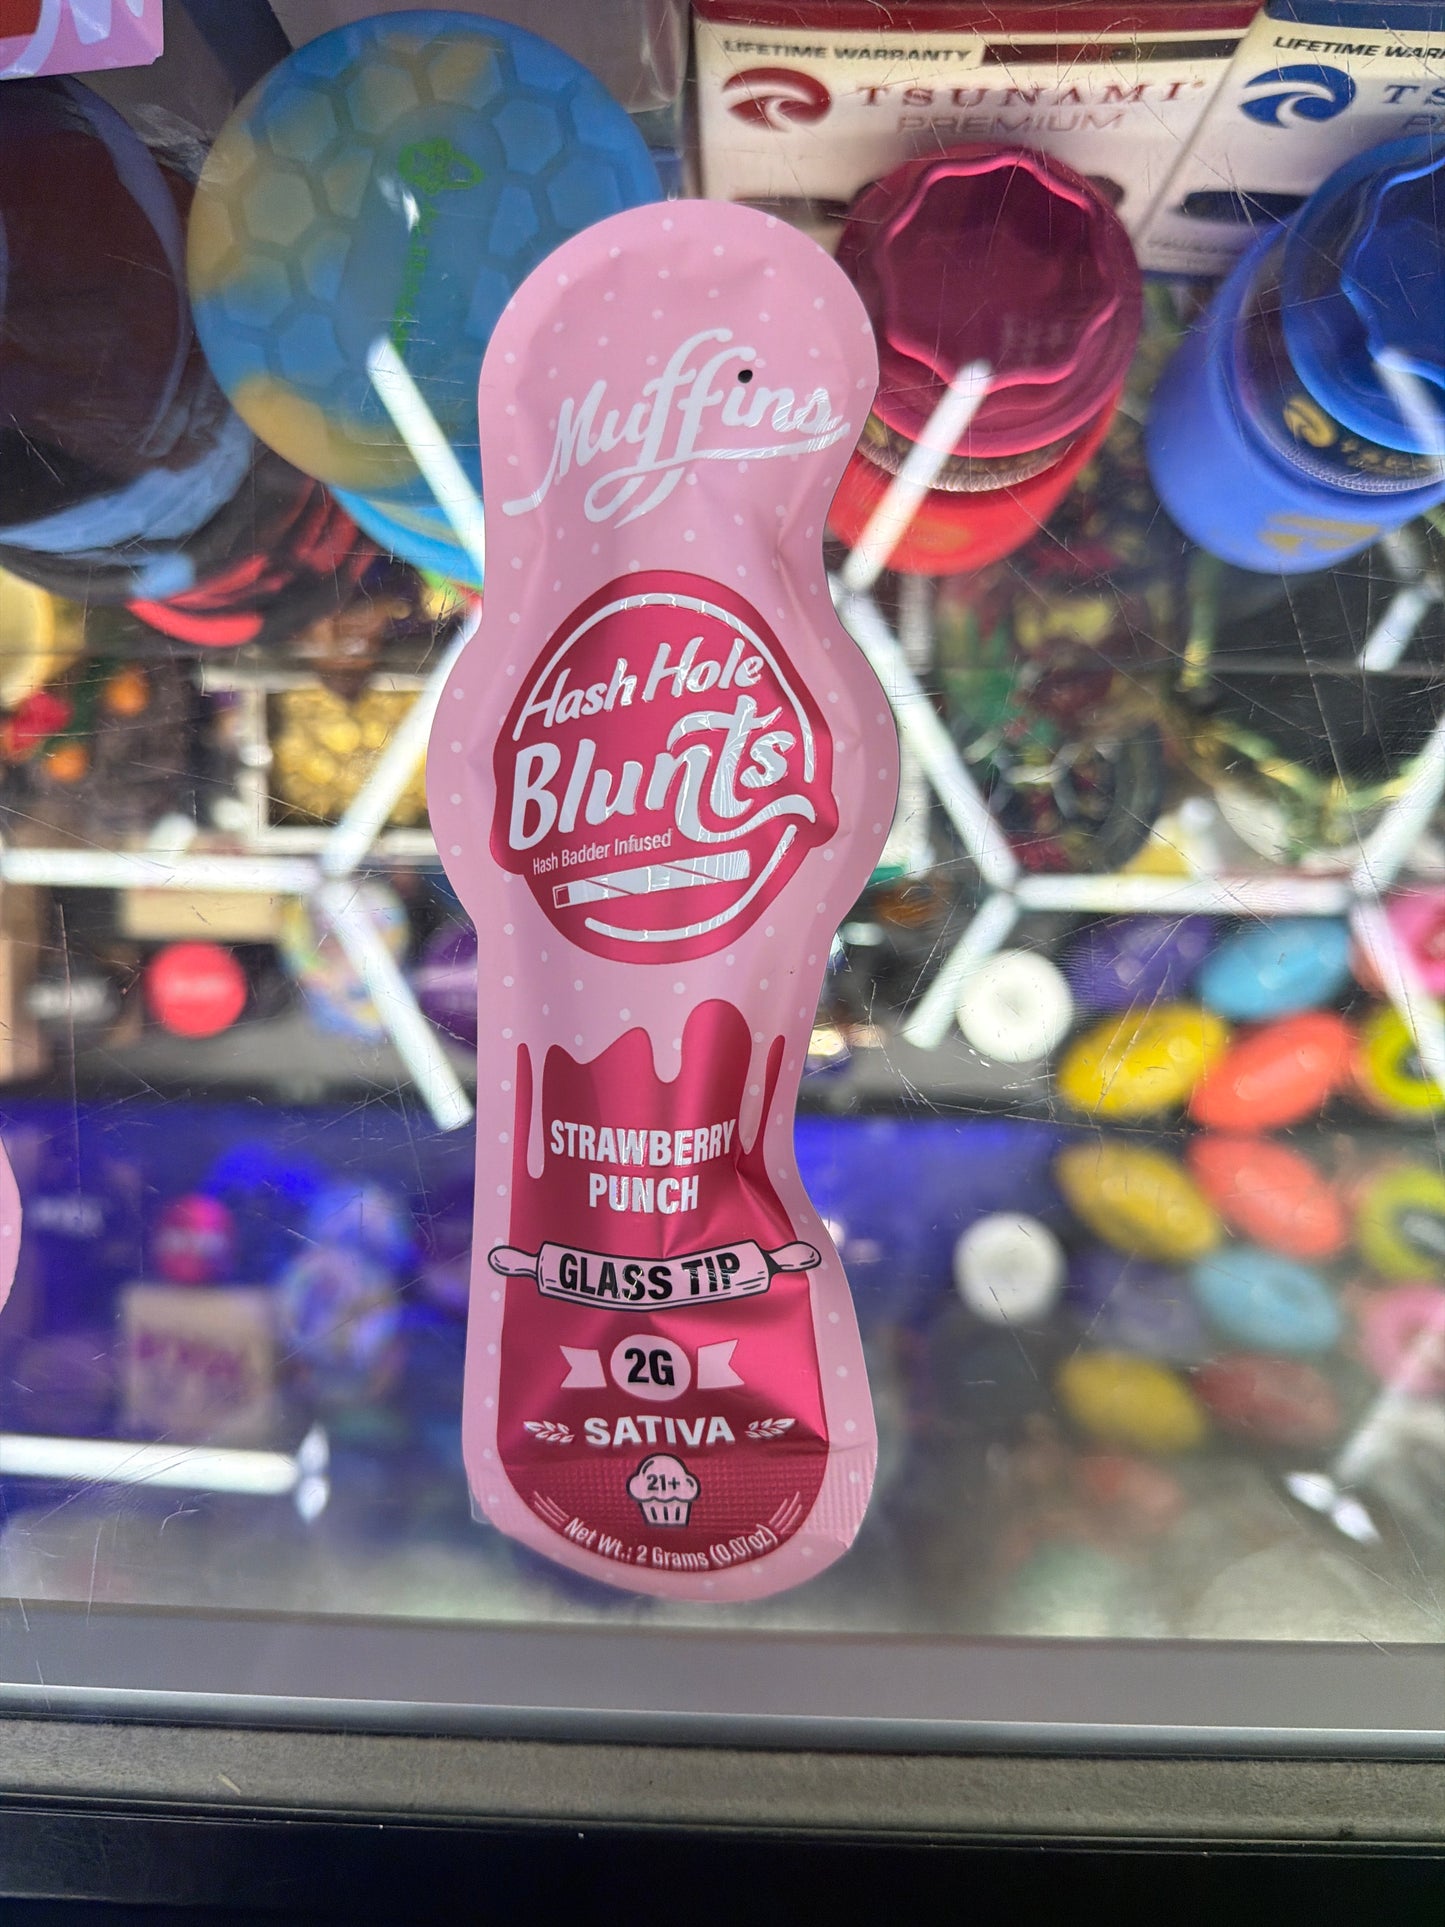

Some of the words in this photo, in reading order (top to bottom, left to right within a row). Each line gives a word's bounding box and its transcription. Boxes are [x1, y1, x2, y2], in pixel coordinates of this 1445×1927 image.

[724, 39, 828, 59] LIFETIME
[833, 47, 971, 62] WARRANTY
[1273, 36, 1381, 55] LIFETIME
[1384, 45, 1445, 59] WAR
[898, 109, 1125, 135] PREMIUM
[502, 328, 850, 529] Muffins
[513, 658, 637, 741] Hash
[643, 636, 764, 702] Hole
[508, 694, 816, 852] Blunts
[533, 853, 559, 875] Hash
[561, 842, 611, 868] Badder
[614, 828, 673, 856] Infused
[550, 1118, 737, 1167] STRAWBERRY
[588, 1172, 699, 1214] PUNCH
[559, 1253, 673, 1300] GLASS
[681, 1252, 741, 1296] TIP
[623, 1347, 676, 1387] 2G
[583, 1416, 736, 1446] SATIVA
[646, 1474, 681, 1492] 21+
[563, 1517, 597, 1546] Net
[636, 1545, 648, 1562] 2
[651, 1547, 709, 1569] Grams
[708, 1523, 779, 1566] (0.07oz)
